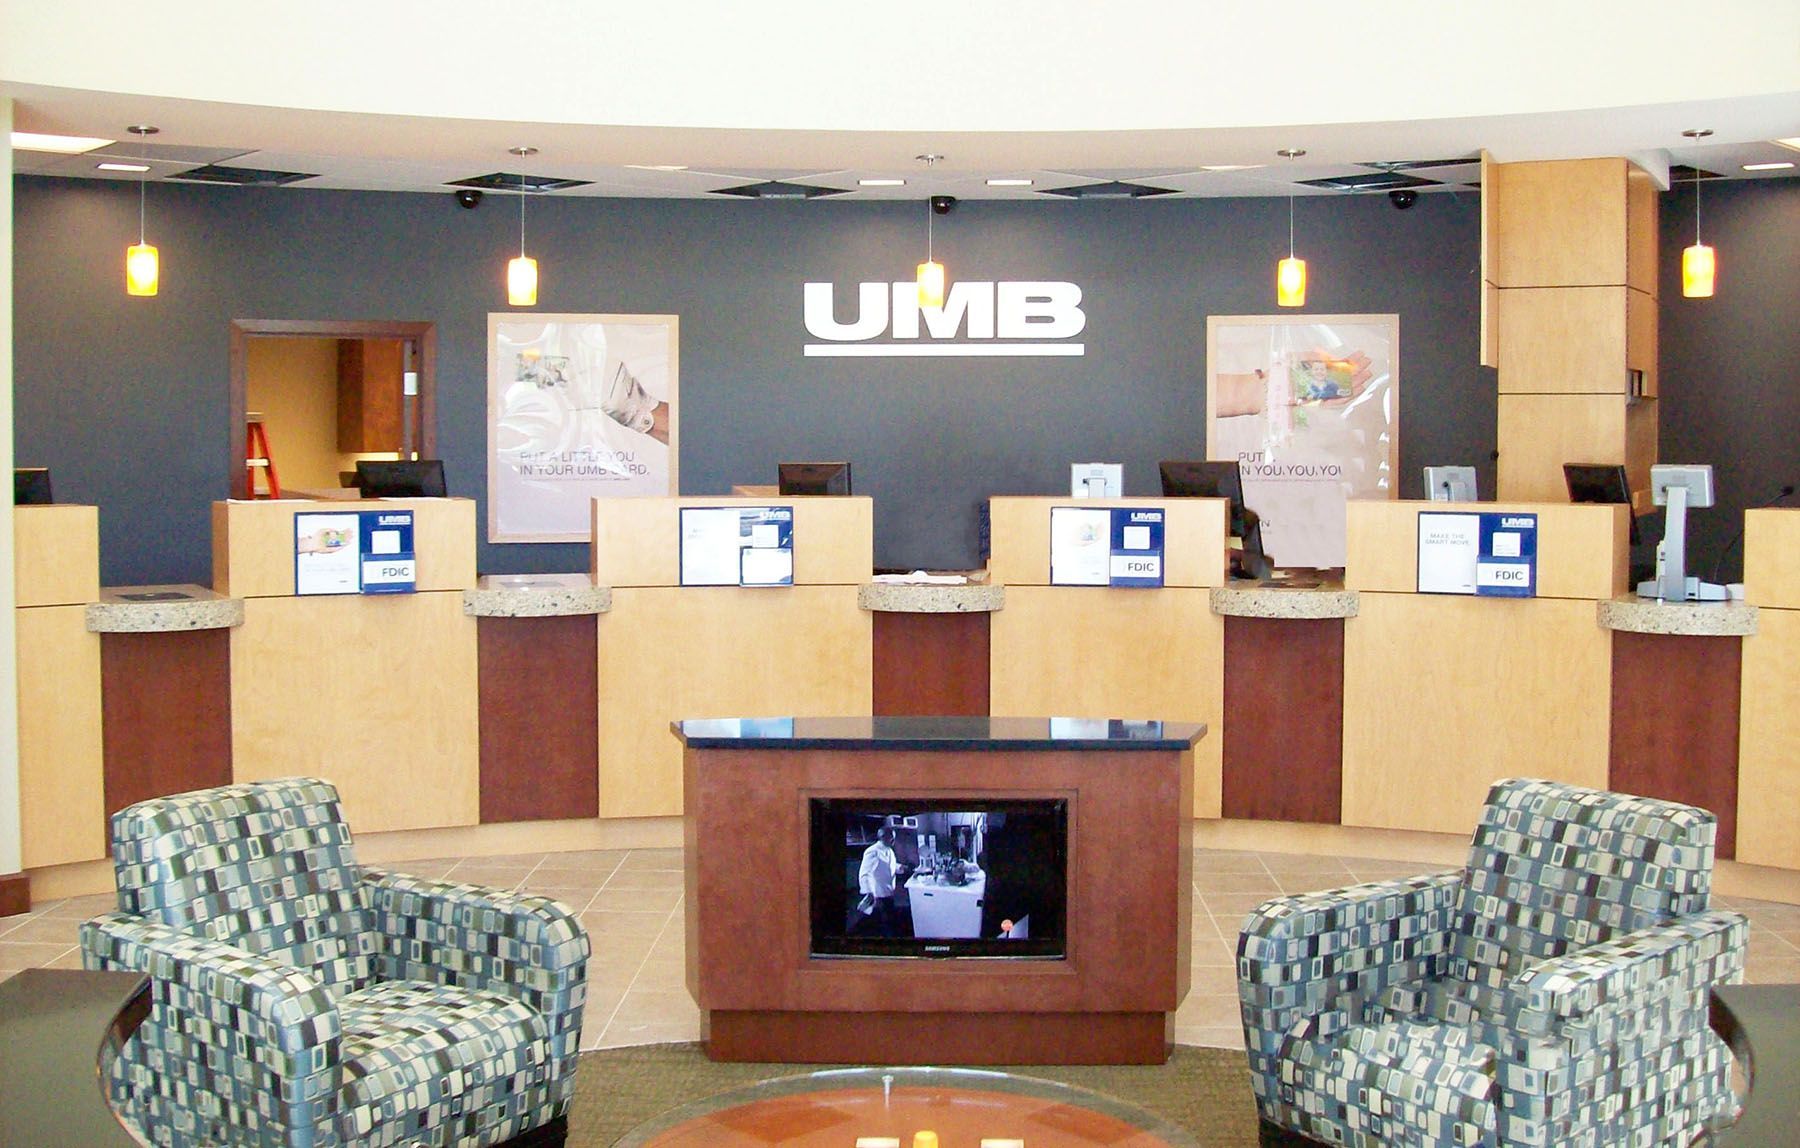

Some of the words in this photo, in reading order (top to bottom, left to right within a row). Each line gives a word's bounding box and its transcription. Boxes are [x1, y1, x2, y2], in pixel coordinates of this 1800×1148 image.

[804, 281, 1086, 341] UMB
[520, 451, 545, 462] PUT
[1238, 452, 1263, 462] PUT
[520, 464, 533, 476] IN
[536, 464, 574, 476] YOUR
[577, 464, 607, 476] UMB
[382, 567, 410, 577] FDIC
[1127, 562, 1155, 572] FDIC
[1495, 571, 1524, 581] FDIC
